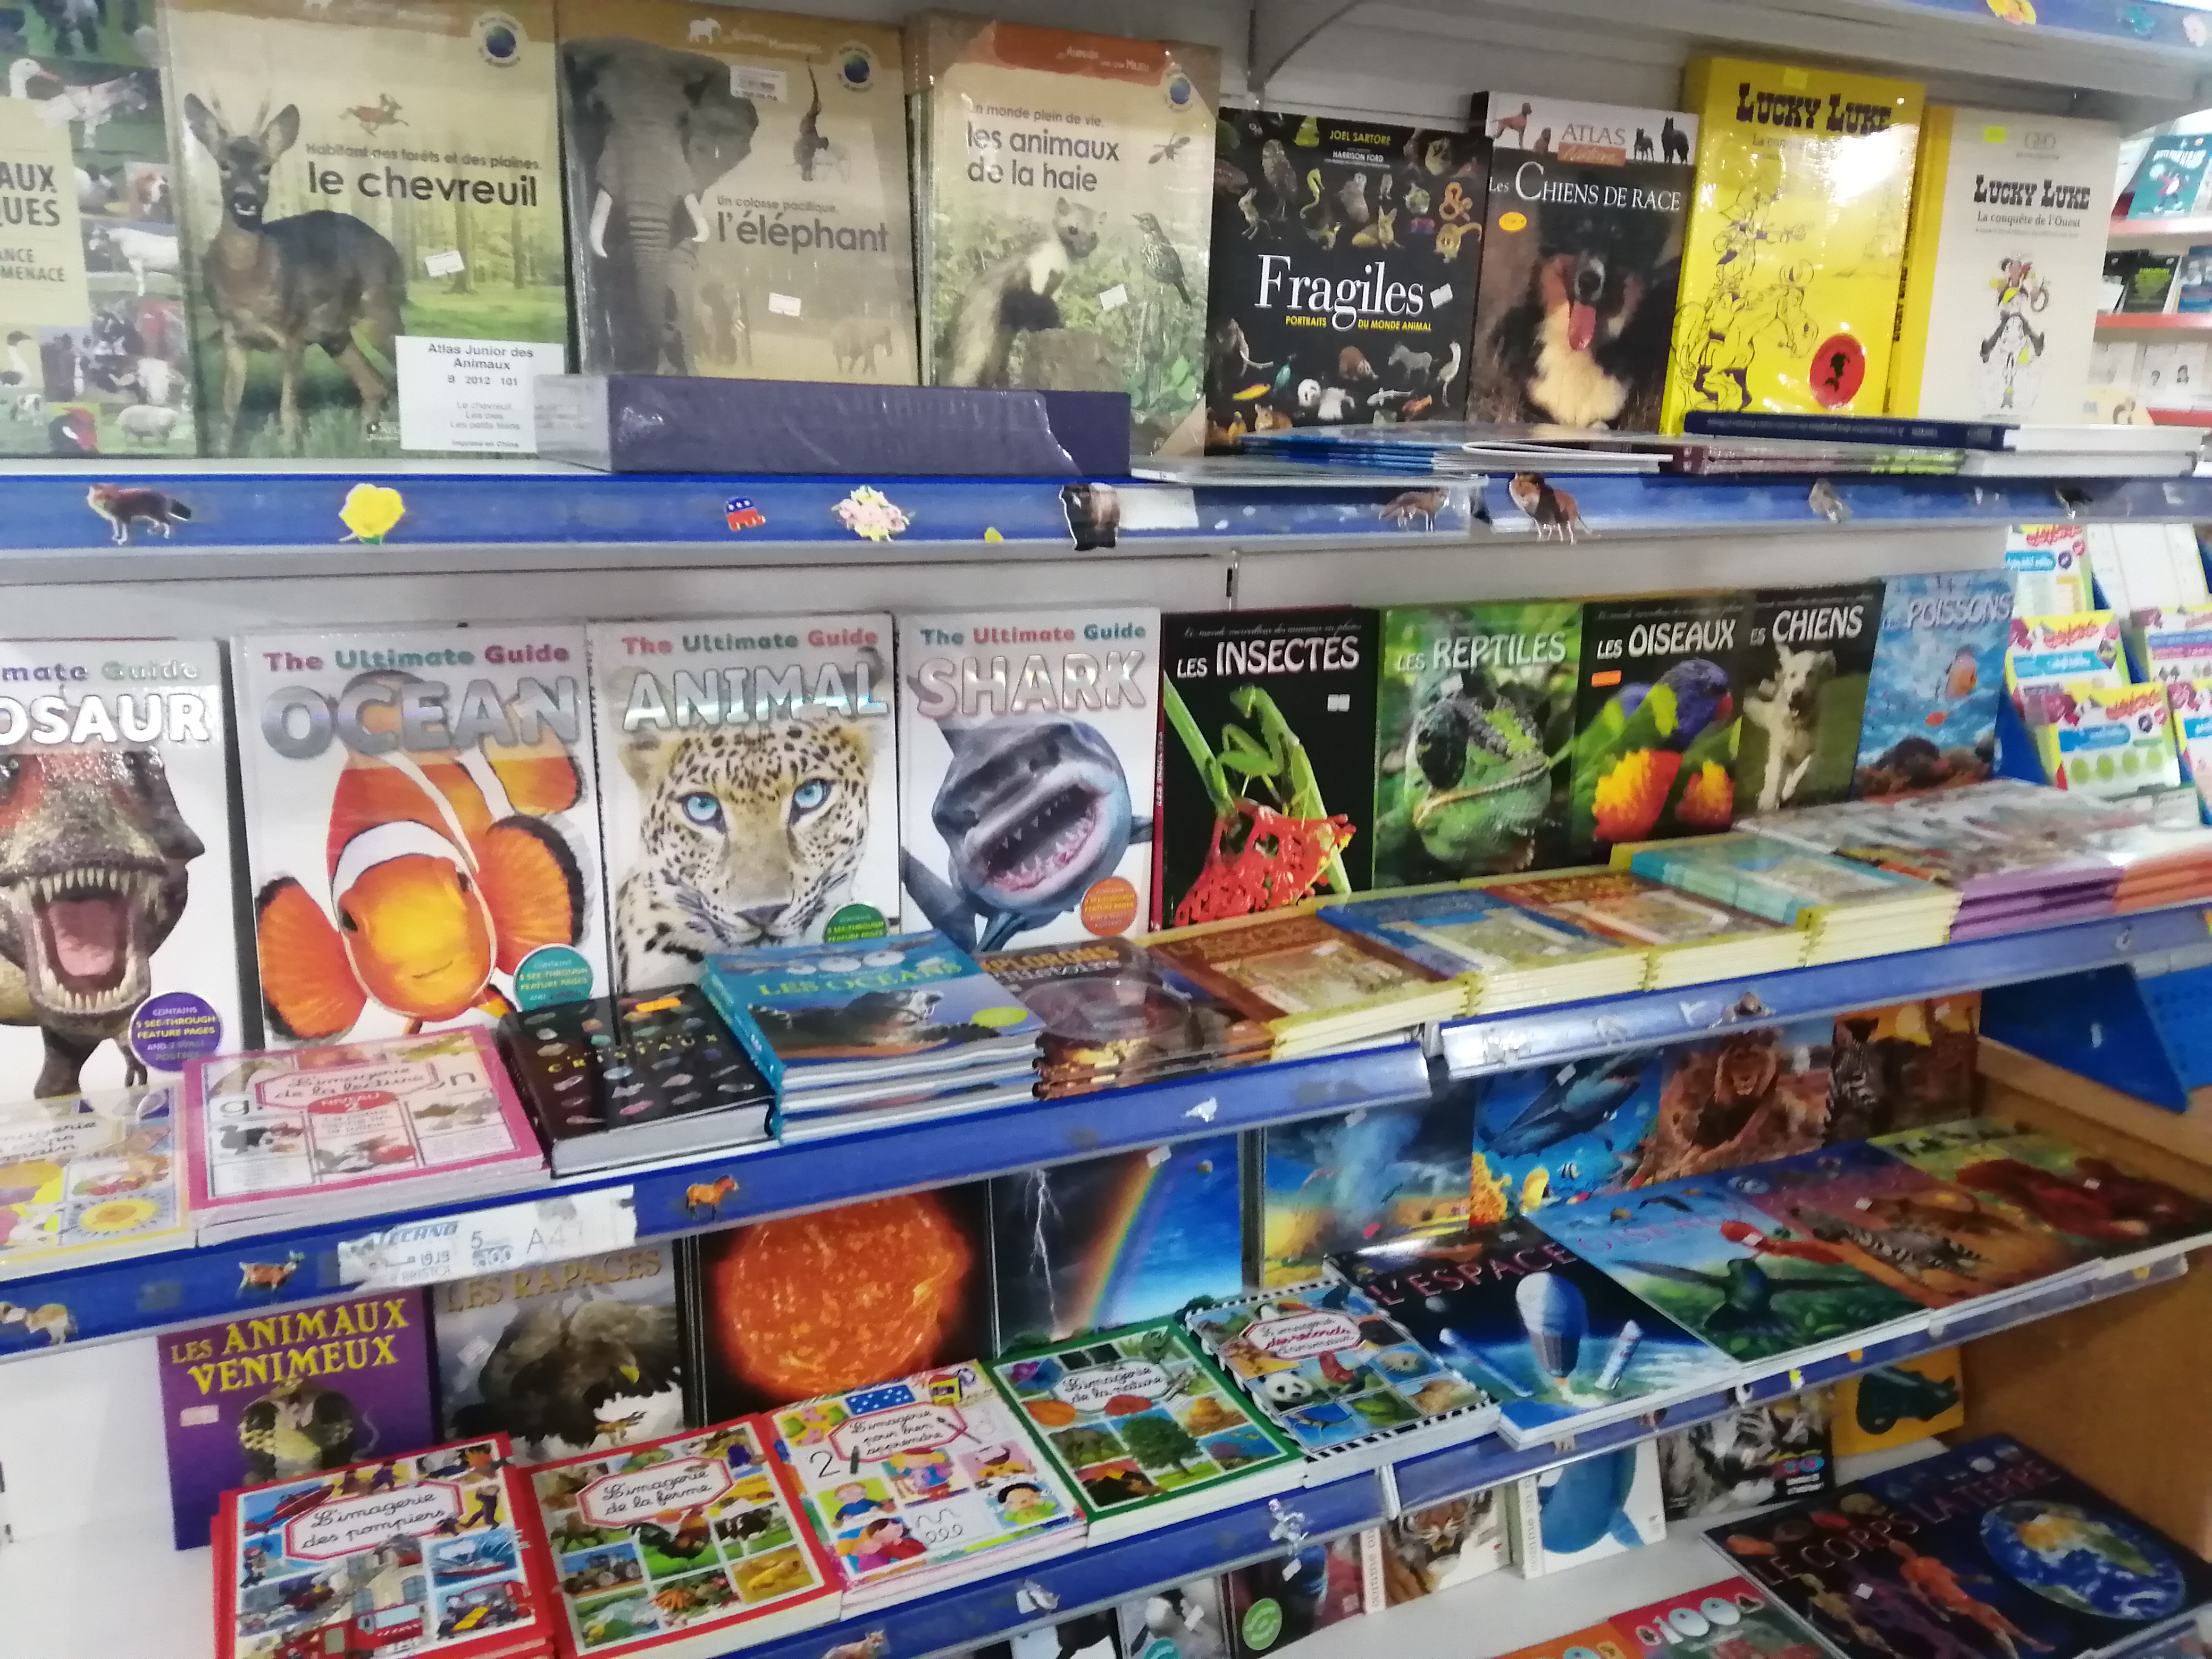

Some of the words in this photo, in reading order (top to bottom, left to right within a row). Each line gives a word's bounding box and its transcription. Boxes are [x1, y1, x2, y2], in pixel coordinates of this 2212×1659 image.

[986, 105, 1030, 119] monde
[1034, 110, 1062, 122] plein
[1066, 112, 1082, 124] de
[1736, 82, 1822, 130] LUCKY
[967, 120, 1002, 149] les
[1009, 128, 1120, 161] animaux
[1330, 130, 1350, 141] JOEL
[1353, 132, 1391, 145] SARTORE
[1561, 123, 1626, 146] ATLAS
[308, 161, 345, 195] le
[357, 166, 538, 206] chevreuil
[967, 155, 1004, 184] de
[1012, 159, 1034, 187] la
[1043, 162, 1097, 192] haie
[1514, 160, 1599, 205] CHIENS
[1603, 185, 1628, 208] DE
[1631, 188, 1681, 211] RACE
[1974, 174, 2037, 206] LUCKY
[2041, 178, 2090, 210] LUKE
[0, 196, 61, 227] UES
[2034, 214, 2047, 225] de
[718, 210, 889, 255] l'éléphant
[1254, 254, 1424, 331] Fragiles
[1285, 316, 1327, 328] PORTRAITS
[1358, 319, 1369, 329] DU
[1371, 320, 1401, 331] MONDE
[1401, 321, 1432, 332] ANIMAL
[429, 343, 461, 354] Atlas
[466, 346, 507, 357] Junior
[510, 347, 534, 358] des
[454, 358, 511, 370] Animaux
[622, 636, 673, 656] The
[682, 632, 798, 653] Ultimate
[806, 627, 879, 647] Guide
[919, 628, 965, 646] The
[973, 627, 1076, 644] Ultimate
[1083, 622, 1146, 640] Guide
[1597, 639, 1622, 660] LES
[1628, 618, 1737, 658] OISEAUX
[1772, 605, 1864, 643] CHIENS
[101, 660, 198, 680] Guide
[262, 651, 324, 672] The
[334, 648, 475, 671] Ultimate
[484, 643, 570, 664] Guide
[1177, 657, 1208, 678] LES
[1216, 635, 1361, 677] INSECTES
[1432, 631, 1567, 674] REPTILES
[622, 662, 889, 731] ANIMAL
[917, 650, 1146, 720] SHARK
[261, 675, 581, 760] OCEAN
[153, 1006, 198, 1016] CONTAINS
[137, 1028, 181, 1039] FEATURE
[184, 1027, 215, 1035] PAGES
[513, 1250, 663, 1300] RAPACES
[170, 1338, 213, 1364] LES
[222, 1298, 409, 1355] ANIMAUX
[187, 1335, 399, 1395] VENIMEUX
[809, 1449, 841, 1479] 2
[310, 1492, 435, 1528] L'imagerie
[301, 1532, 339, 1549] des
[346, 1509, 446, 1542] pompiers
